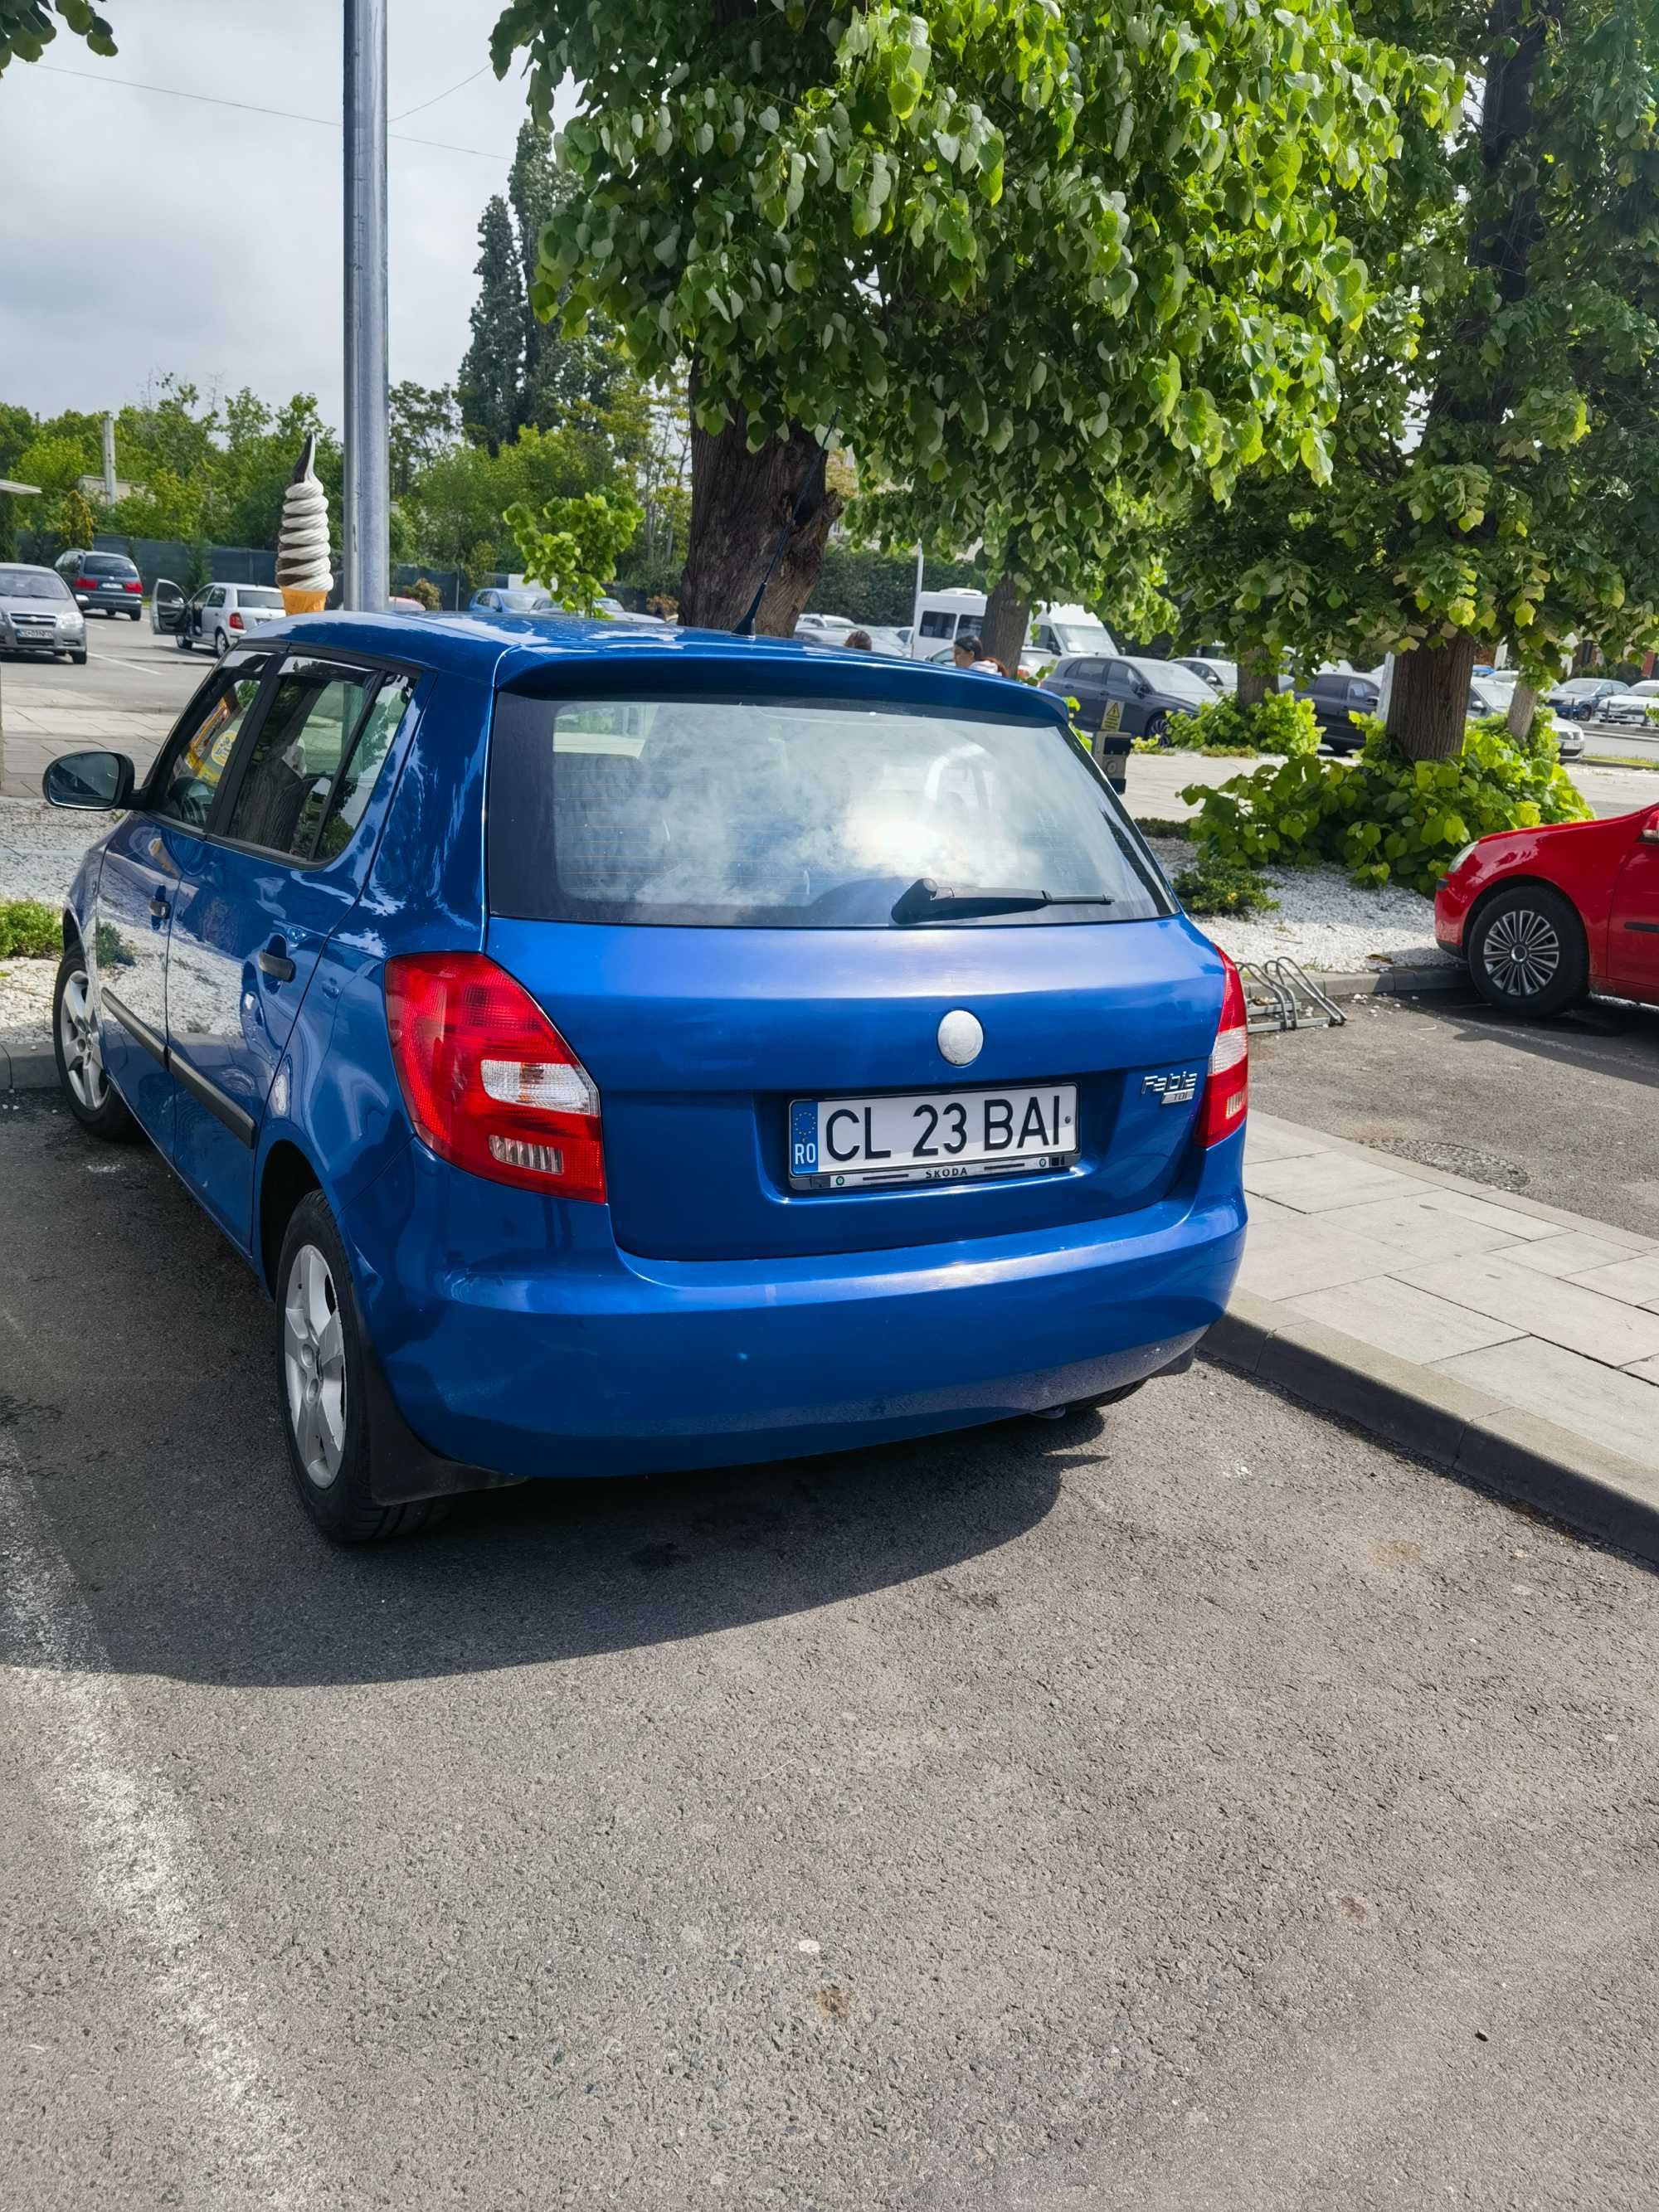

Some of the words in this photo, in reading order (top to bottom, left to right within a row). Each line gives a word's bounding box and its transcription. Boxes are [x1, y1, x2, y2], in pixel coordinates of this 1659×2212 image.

[1141, 1071, 1198, 1094] Fabia
[826, 1106, 891, 1161] CL
[912, 1102, 967, 1157] 23
[984, 1095, 1060, 1151] BAI
[795, 1143, 816, 1164] RO
